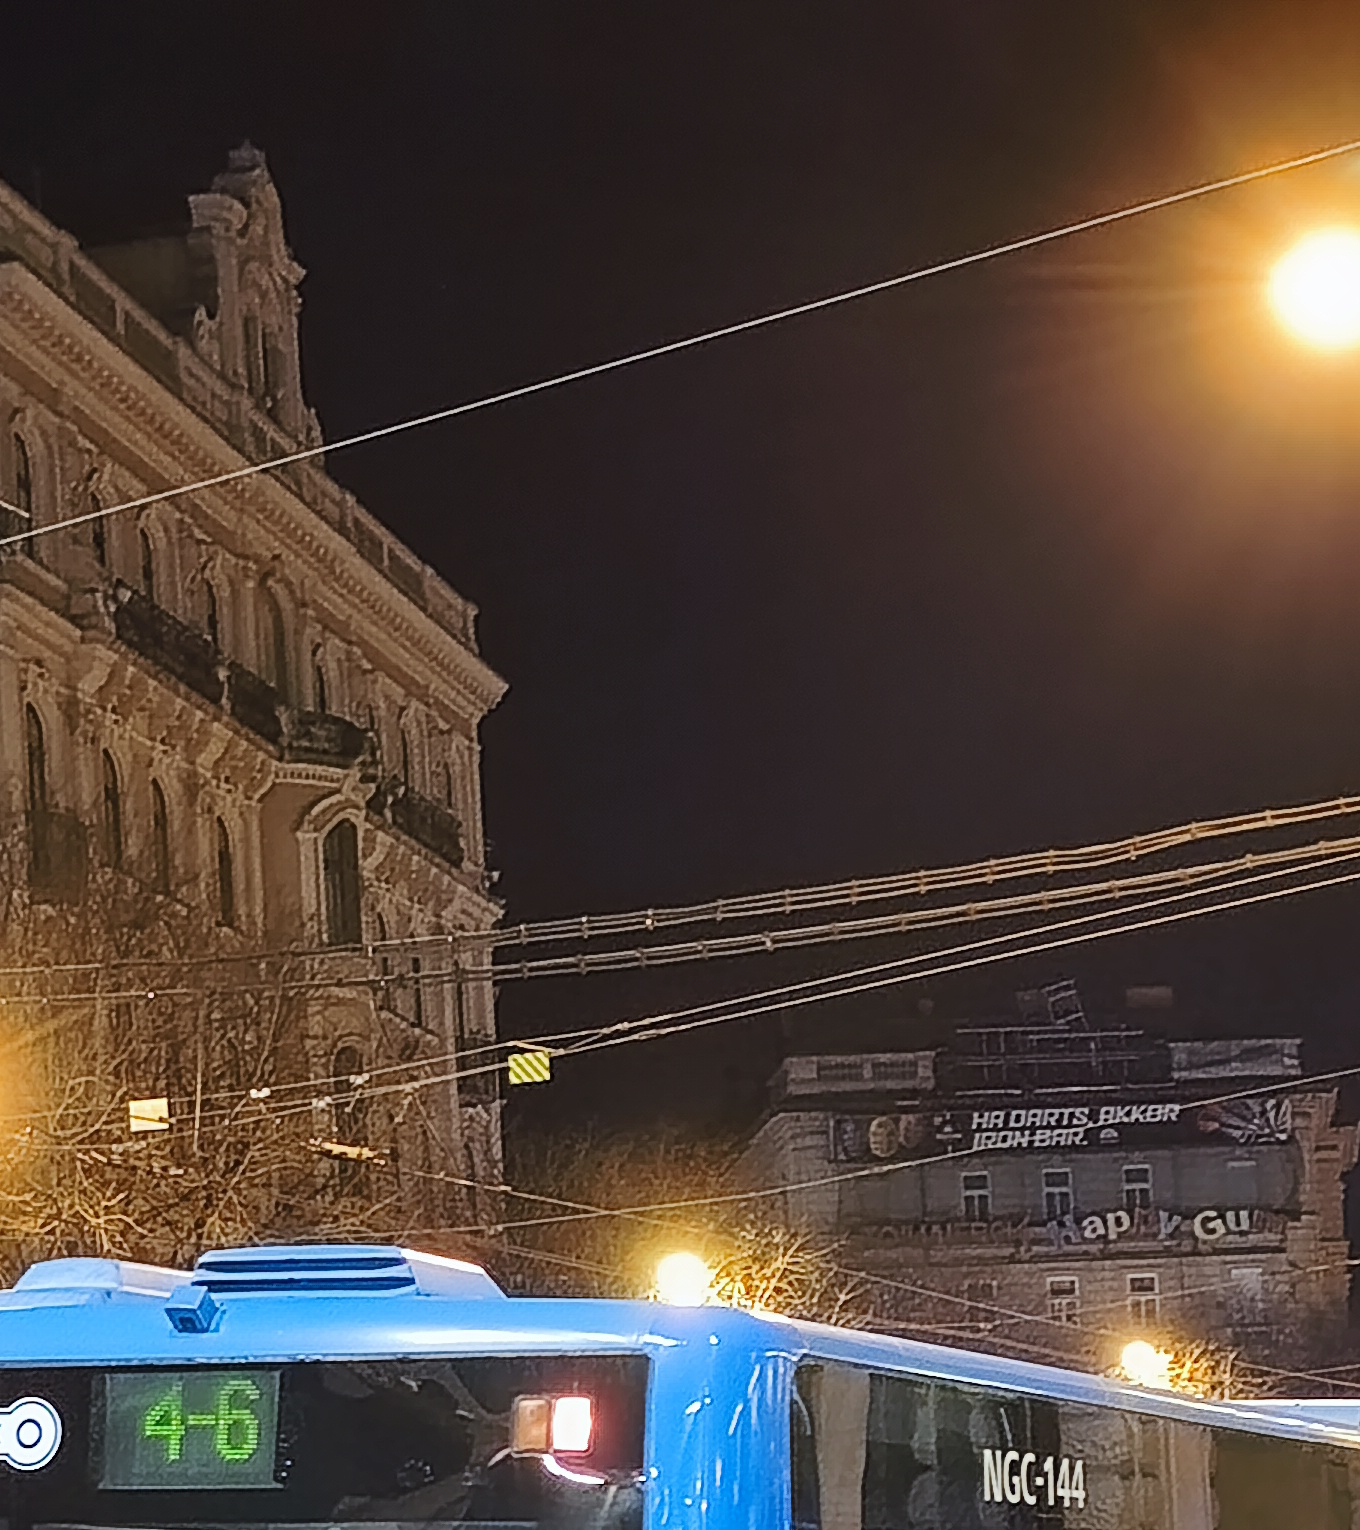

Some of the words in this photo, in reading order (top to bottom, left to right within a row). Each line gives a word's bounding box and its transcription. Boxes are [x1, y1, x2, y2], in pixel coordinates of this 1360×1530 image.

[972, 1111, 1004, 1129] HA
[142, 1380, 260, 1464] 4-6
[983, 1449, 1086, 1509] NGC-144
